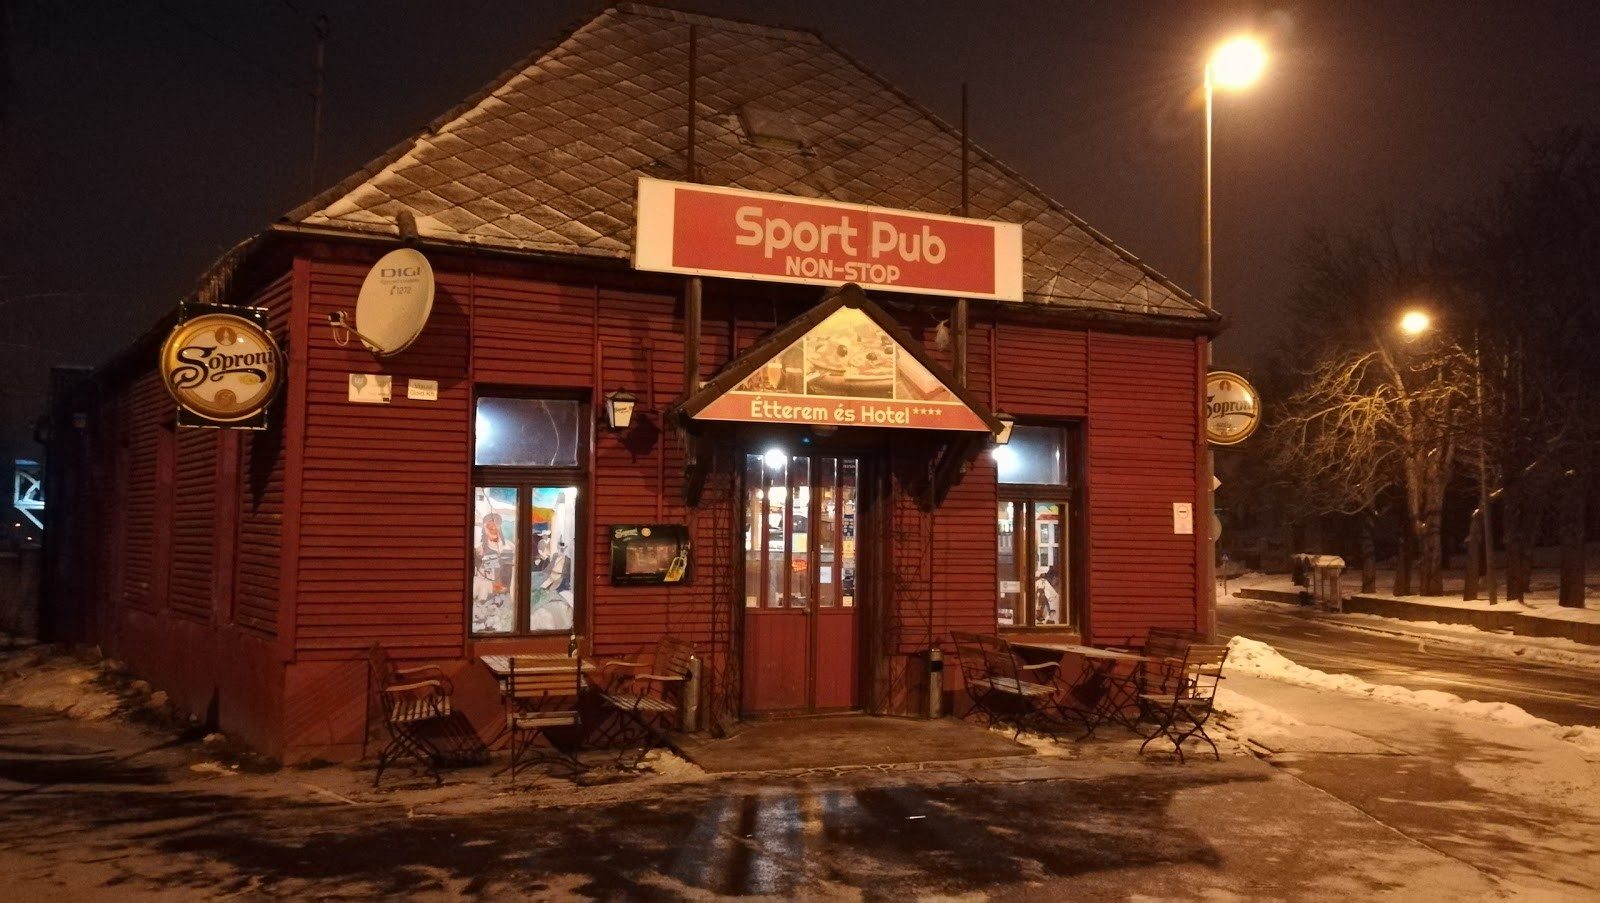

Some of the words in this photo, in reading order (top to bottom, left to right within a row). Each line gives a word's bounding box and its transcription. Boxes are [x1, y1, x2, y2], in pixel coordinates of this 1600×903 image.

[735, 206, 858, 258] Sport
[872, 221, 946, 264] Pub
[381, 267, 420, 277] DIGI
[785, 255, 900, 284] NON-STOP
[170, 346, 274, 391] Soproni
[751, 396, 828, 420] Étterem
[834, 403, 856, 422] és
[861, 405, 910, 424] Hotel
